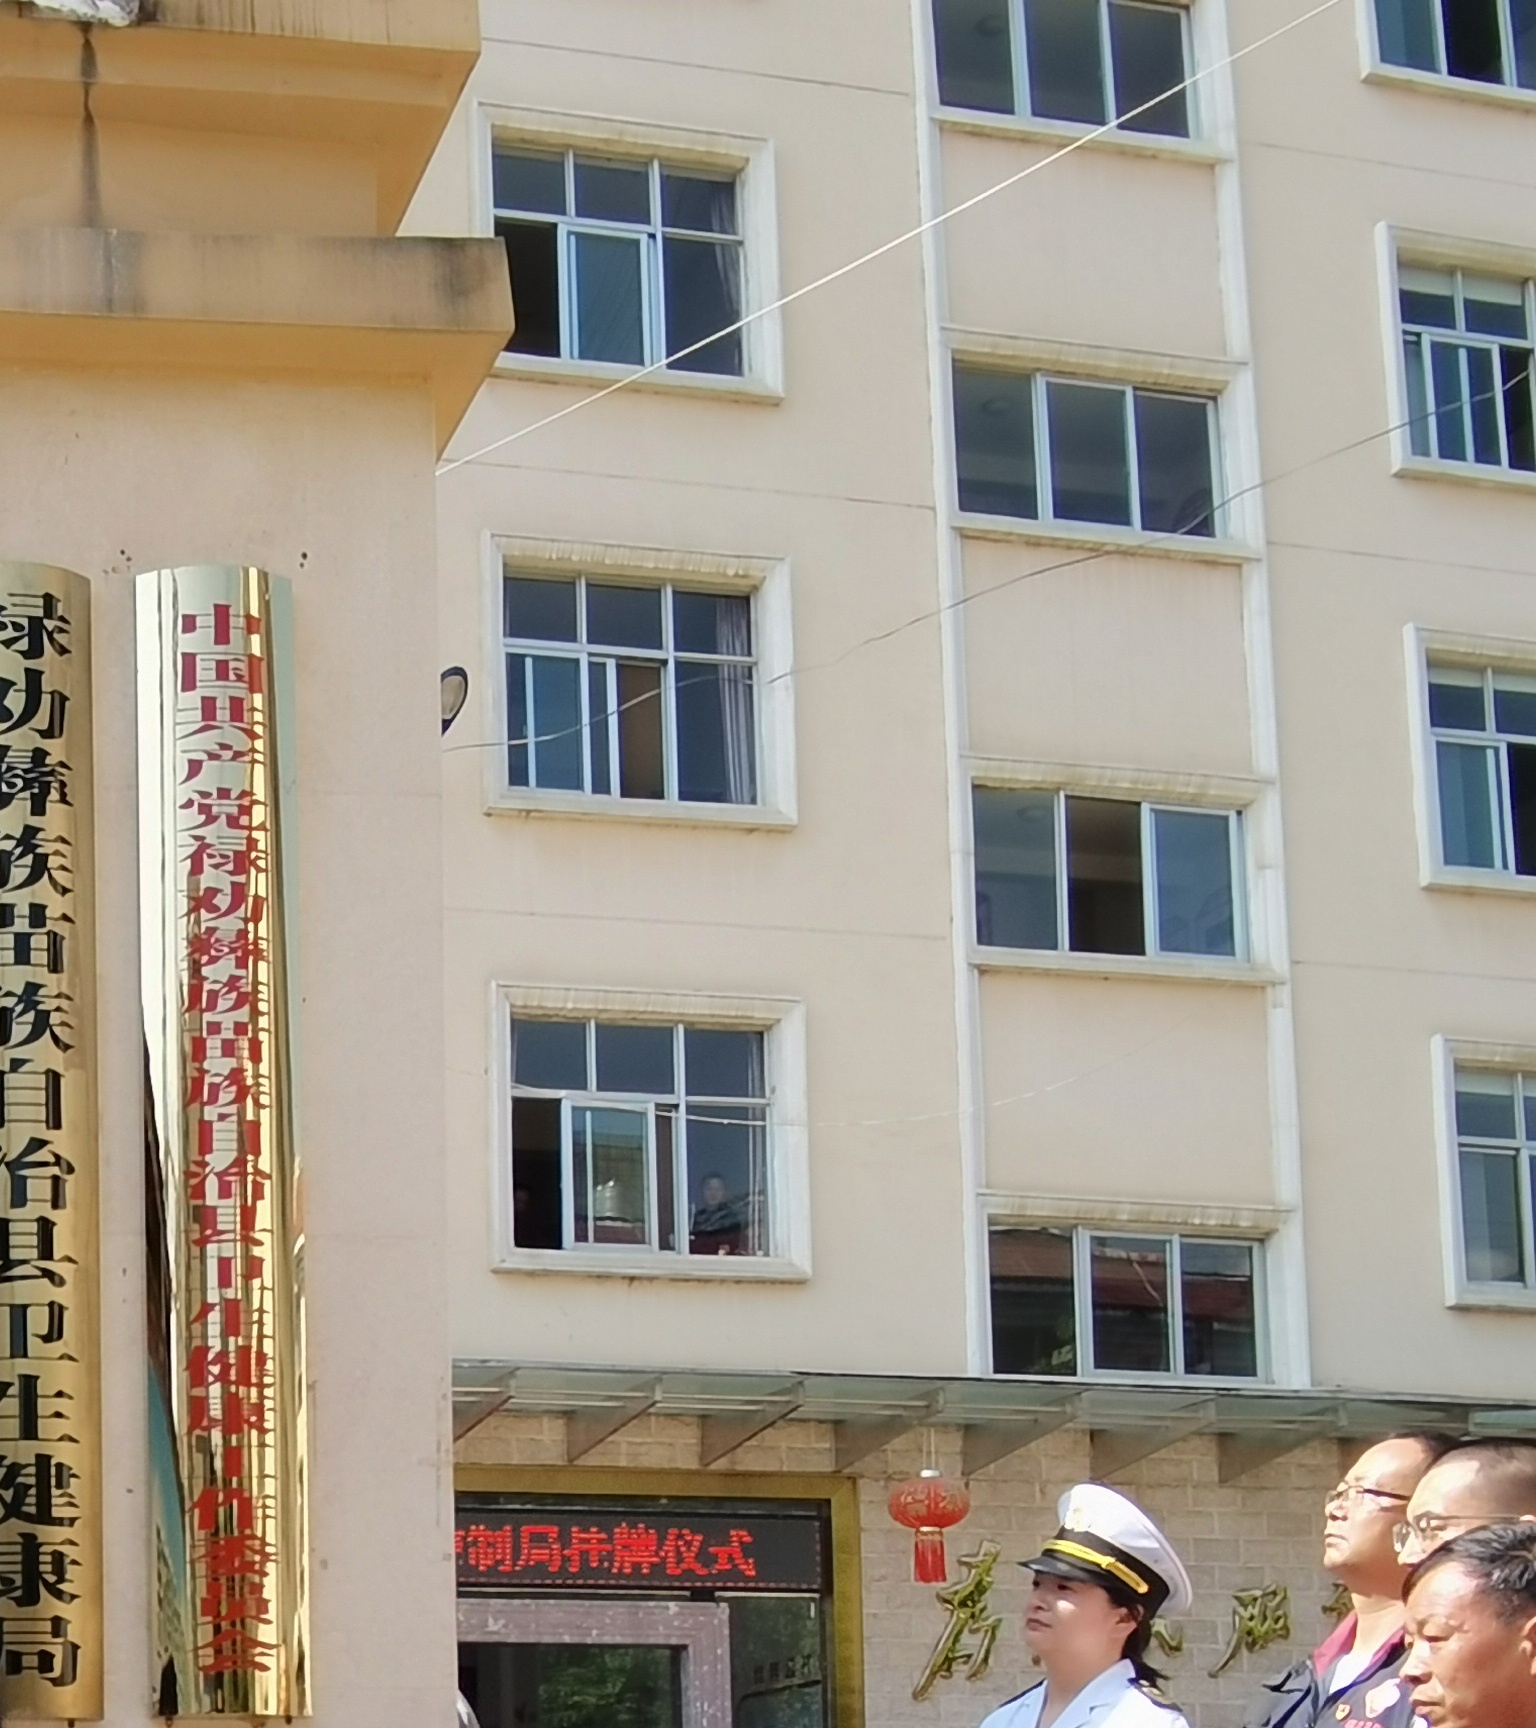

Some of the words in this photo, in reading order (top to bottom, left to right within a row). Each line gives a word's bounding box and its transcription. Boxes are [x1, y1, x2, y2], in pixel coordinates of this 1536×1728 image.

[177, 603, 282, 1672] 中国共产党禄劝彝族苗族自治县卫生健康工作委员会
[455, 1522, 757, 1578] 制局挂牌仪式
